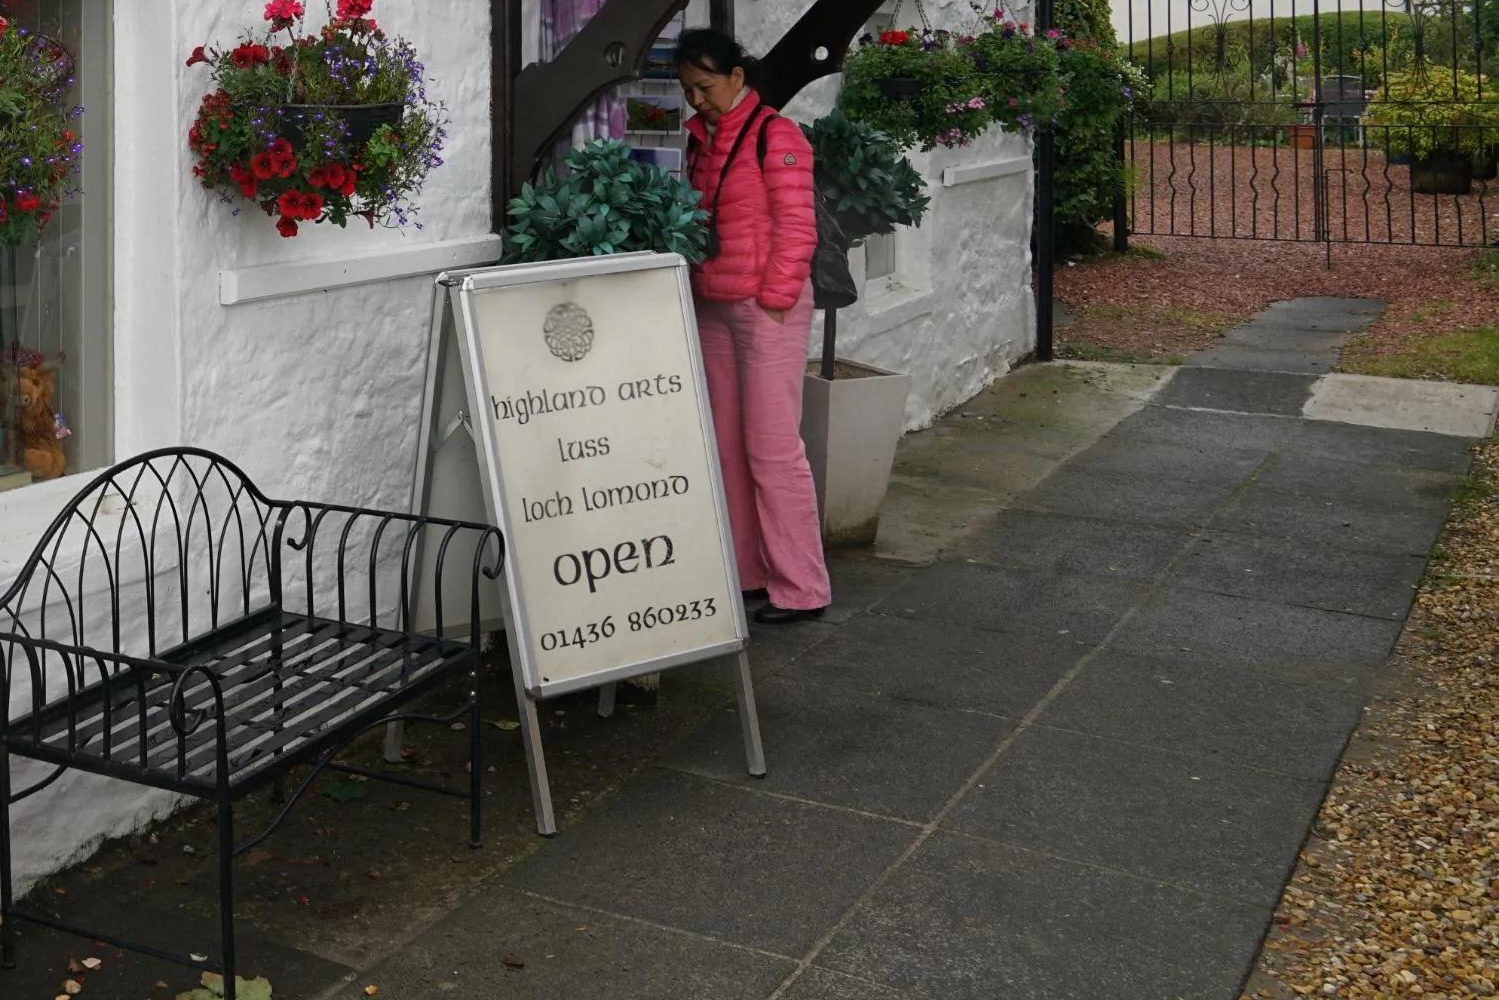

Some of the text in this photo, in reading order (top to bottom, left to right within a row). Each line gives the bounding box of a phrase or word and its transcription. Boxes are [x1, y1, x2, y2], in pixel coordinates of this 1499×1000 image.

[491, 373, 682, 425] highland arts
[559, 436, 610, 462] luss
[523, 474, 689, 523] loch lomond
[554, 532, 676, 593] open
[540, 597, 717, 652] 01436 860233
